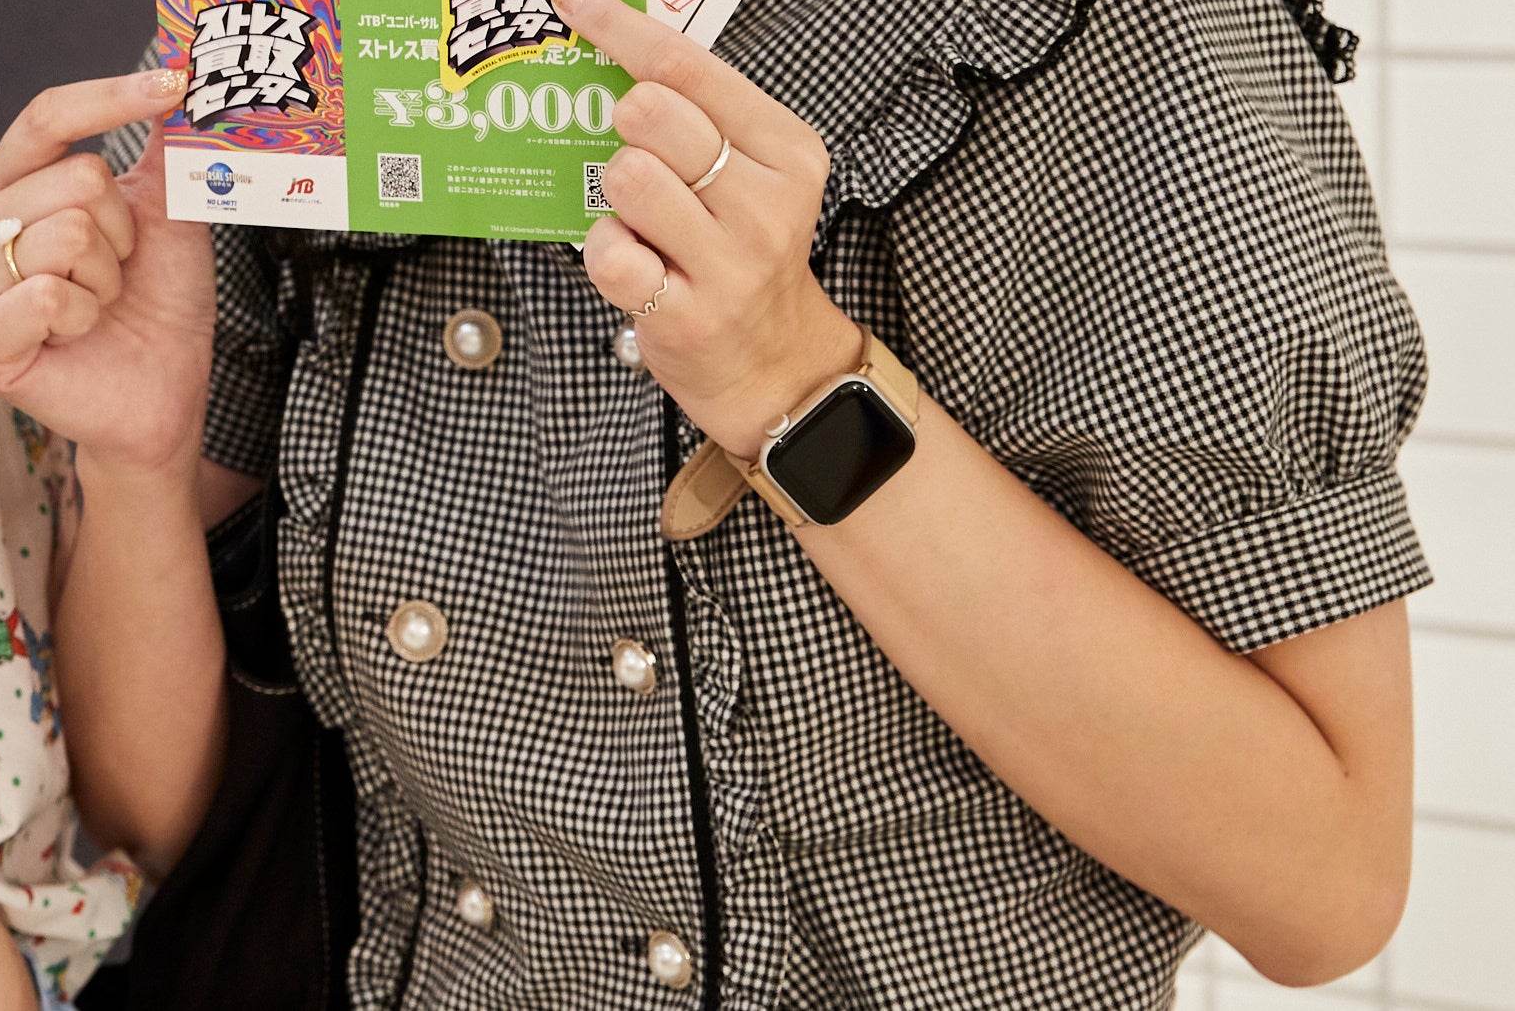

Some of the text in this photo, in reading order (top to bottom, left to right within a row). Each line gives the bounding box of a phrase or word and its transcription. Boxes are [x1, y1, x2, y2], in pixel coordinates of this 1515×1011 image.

[192, 3, 311, 47] ストレス
[449, 12, 564, 67] センター
[188, 34, 306, 91] 買取
[186, 74, 310, 123] センター
[374, 80, 618, 139] ¥3,000
[287, 178, 314, 196] JTB
